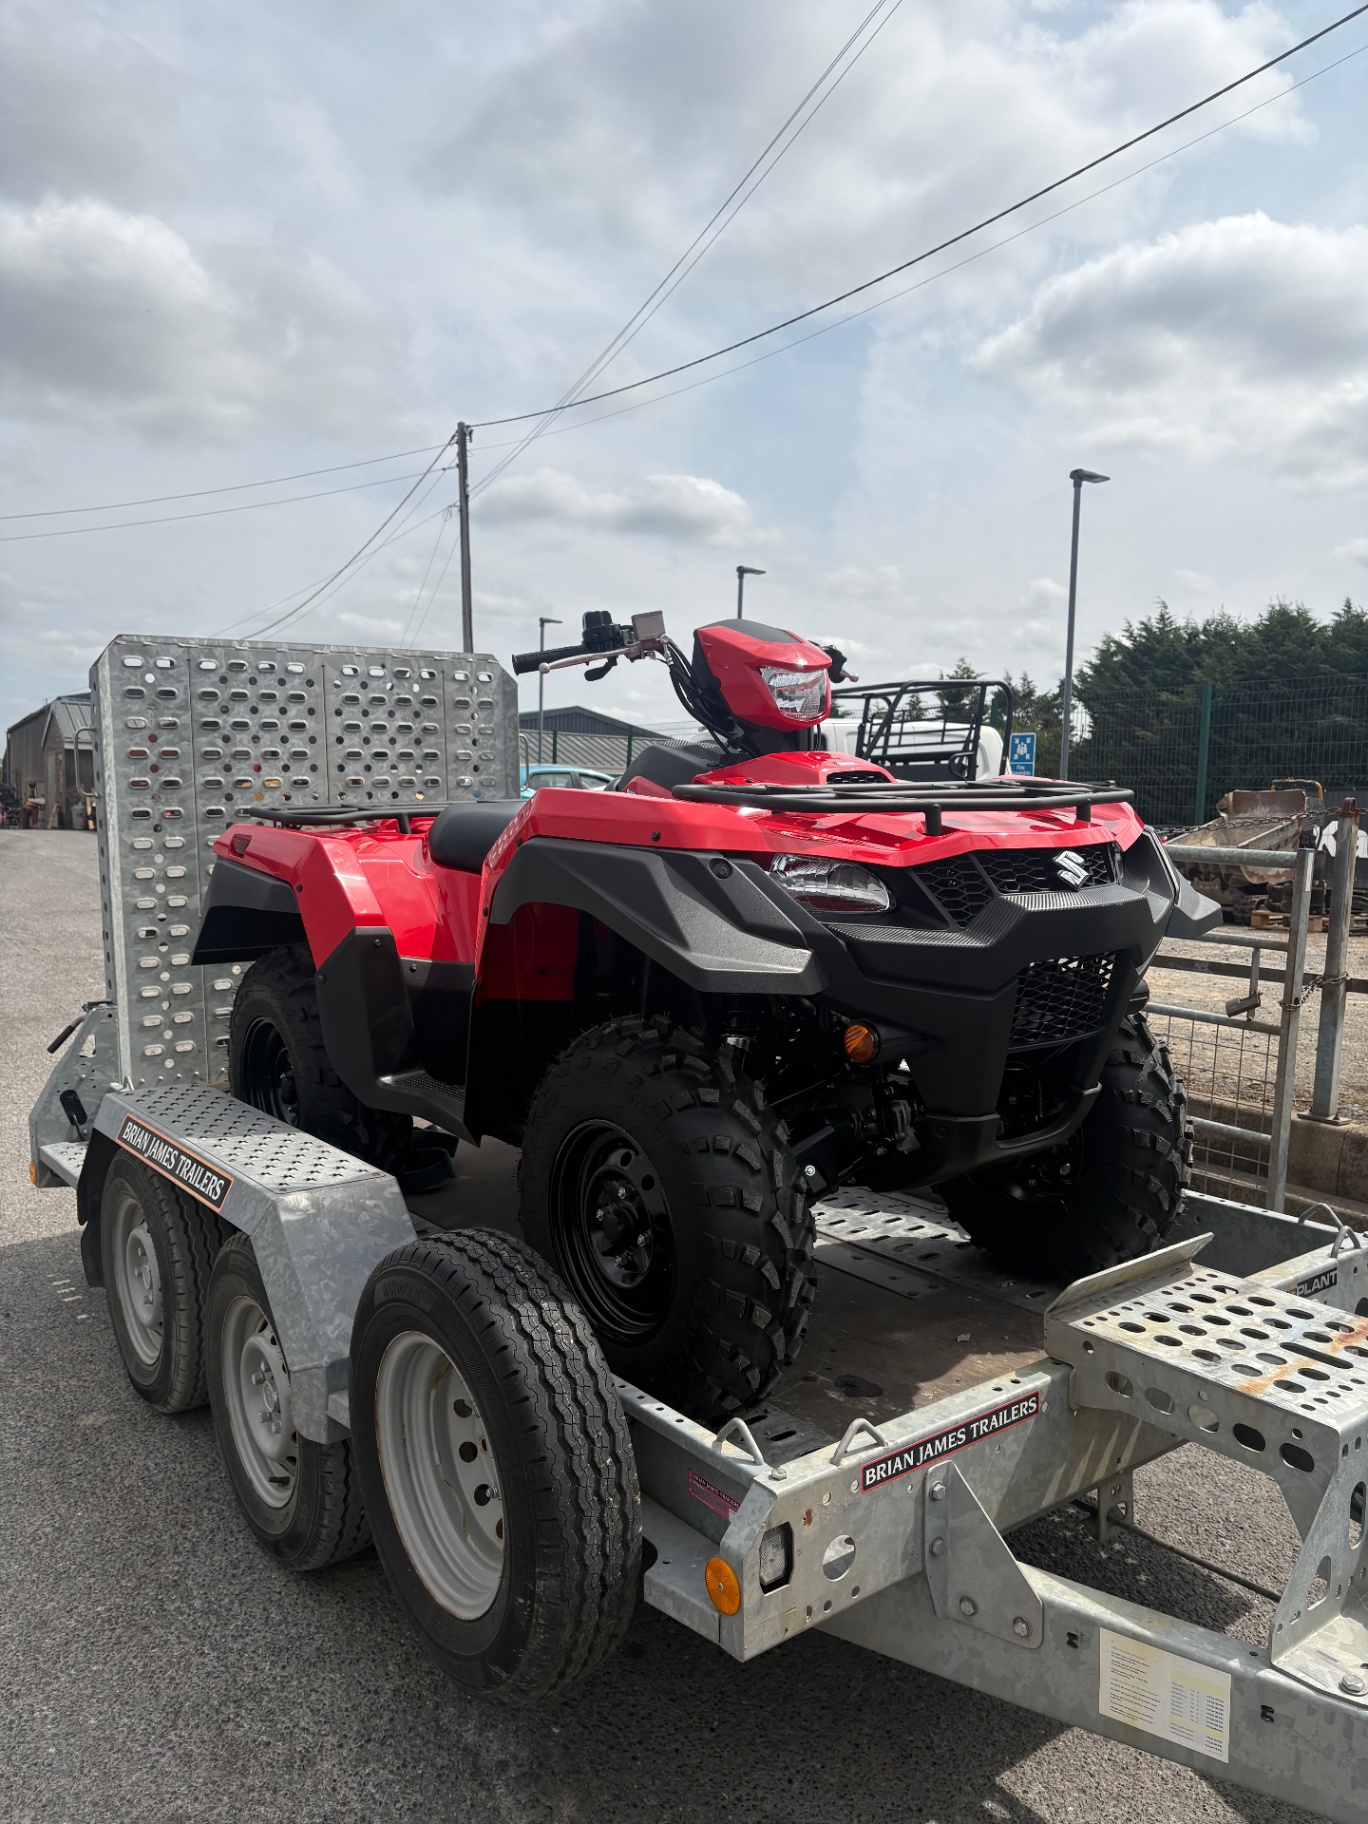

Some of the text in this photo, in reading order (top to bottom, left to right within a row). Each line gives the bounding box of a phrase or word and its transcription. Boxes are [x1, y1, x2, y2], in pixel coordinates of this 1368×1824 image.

[122, 1121, 225, 1200] BRIAN JAMES TRAILERS
[1297, 1270, 1338, 1296] PLANT
[865, 1397, 1037, 1486] BRIAN JAMES TRAILERS
